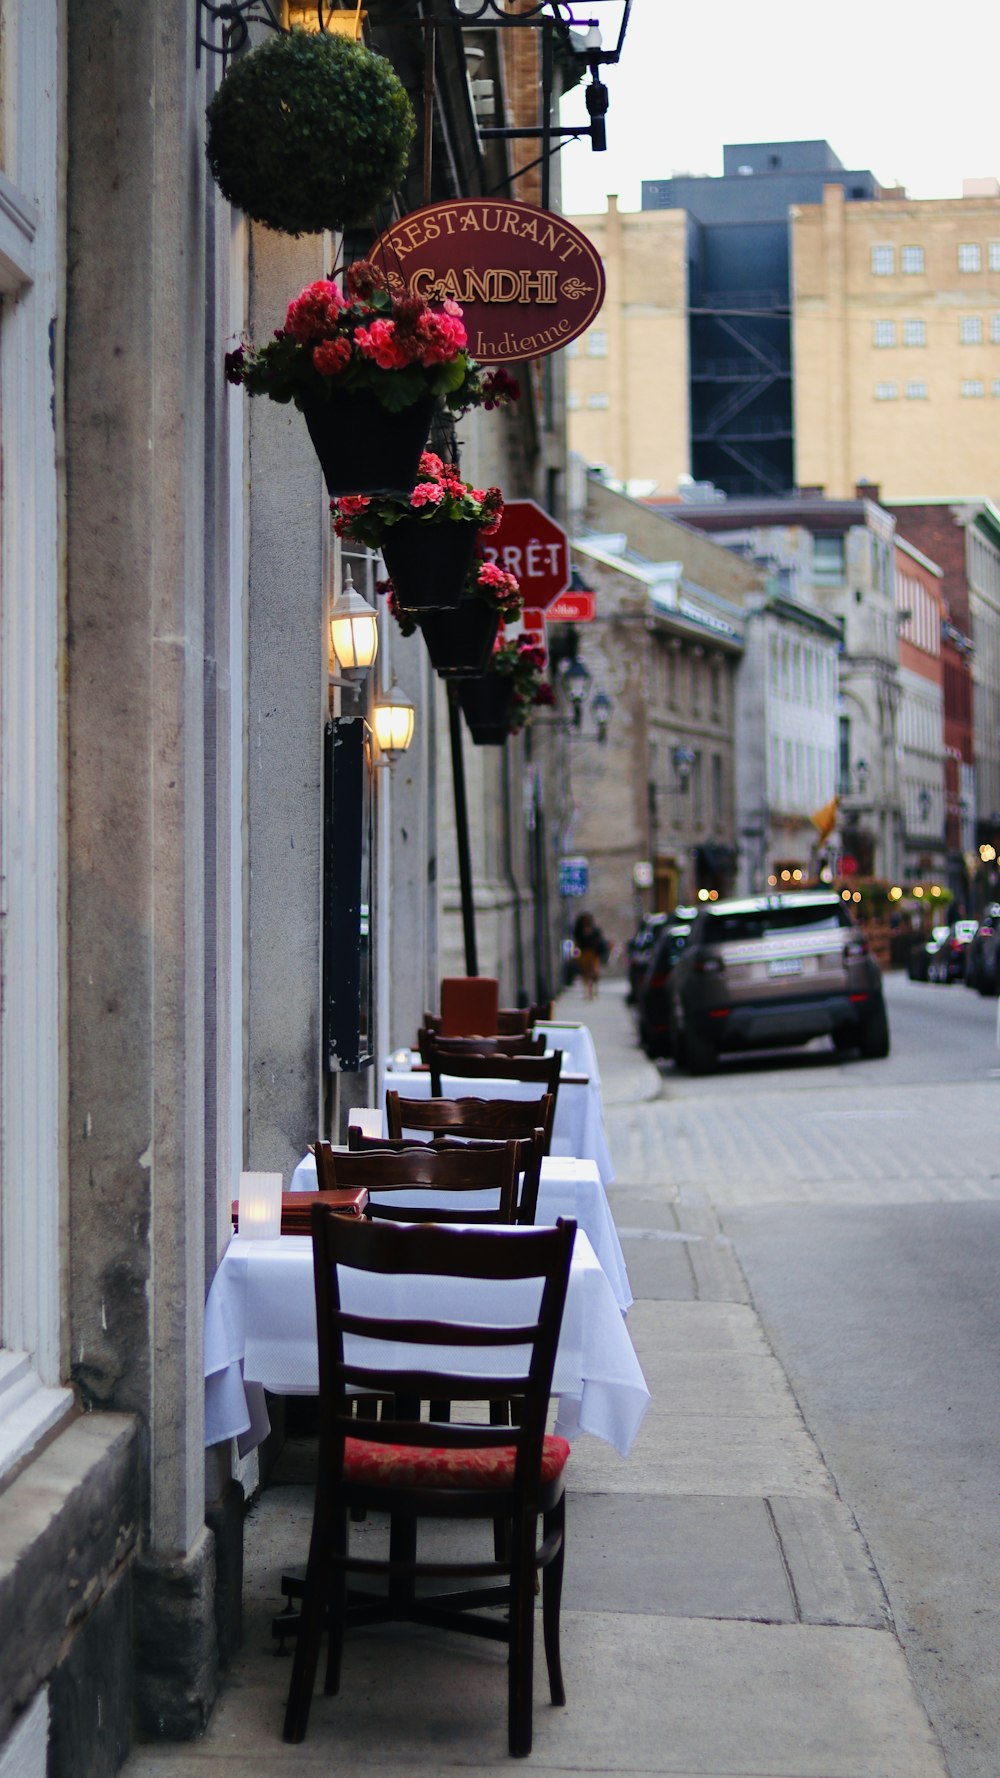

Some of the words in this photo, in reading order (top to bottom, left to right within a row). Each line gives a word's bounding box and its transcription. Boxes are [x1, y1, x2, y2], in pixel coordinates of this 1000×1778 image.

[387, 208, 583, 262] RESTAURANT
[409, 268, 558, 303] GANDHI
[476, 318, 571, 355] Indienne
[484, 538, 562, 577] RRÊT
